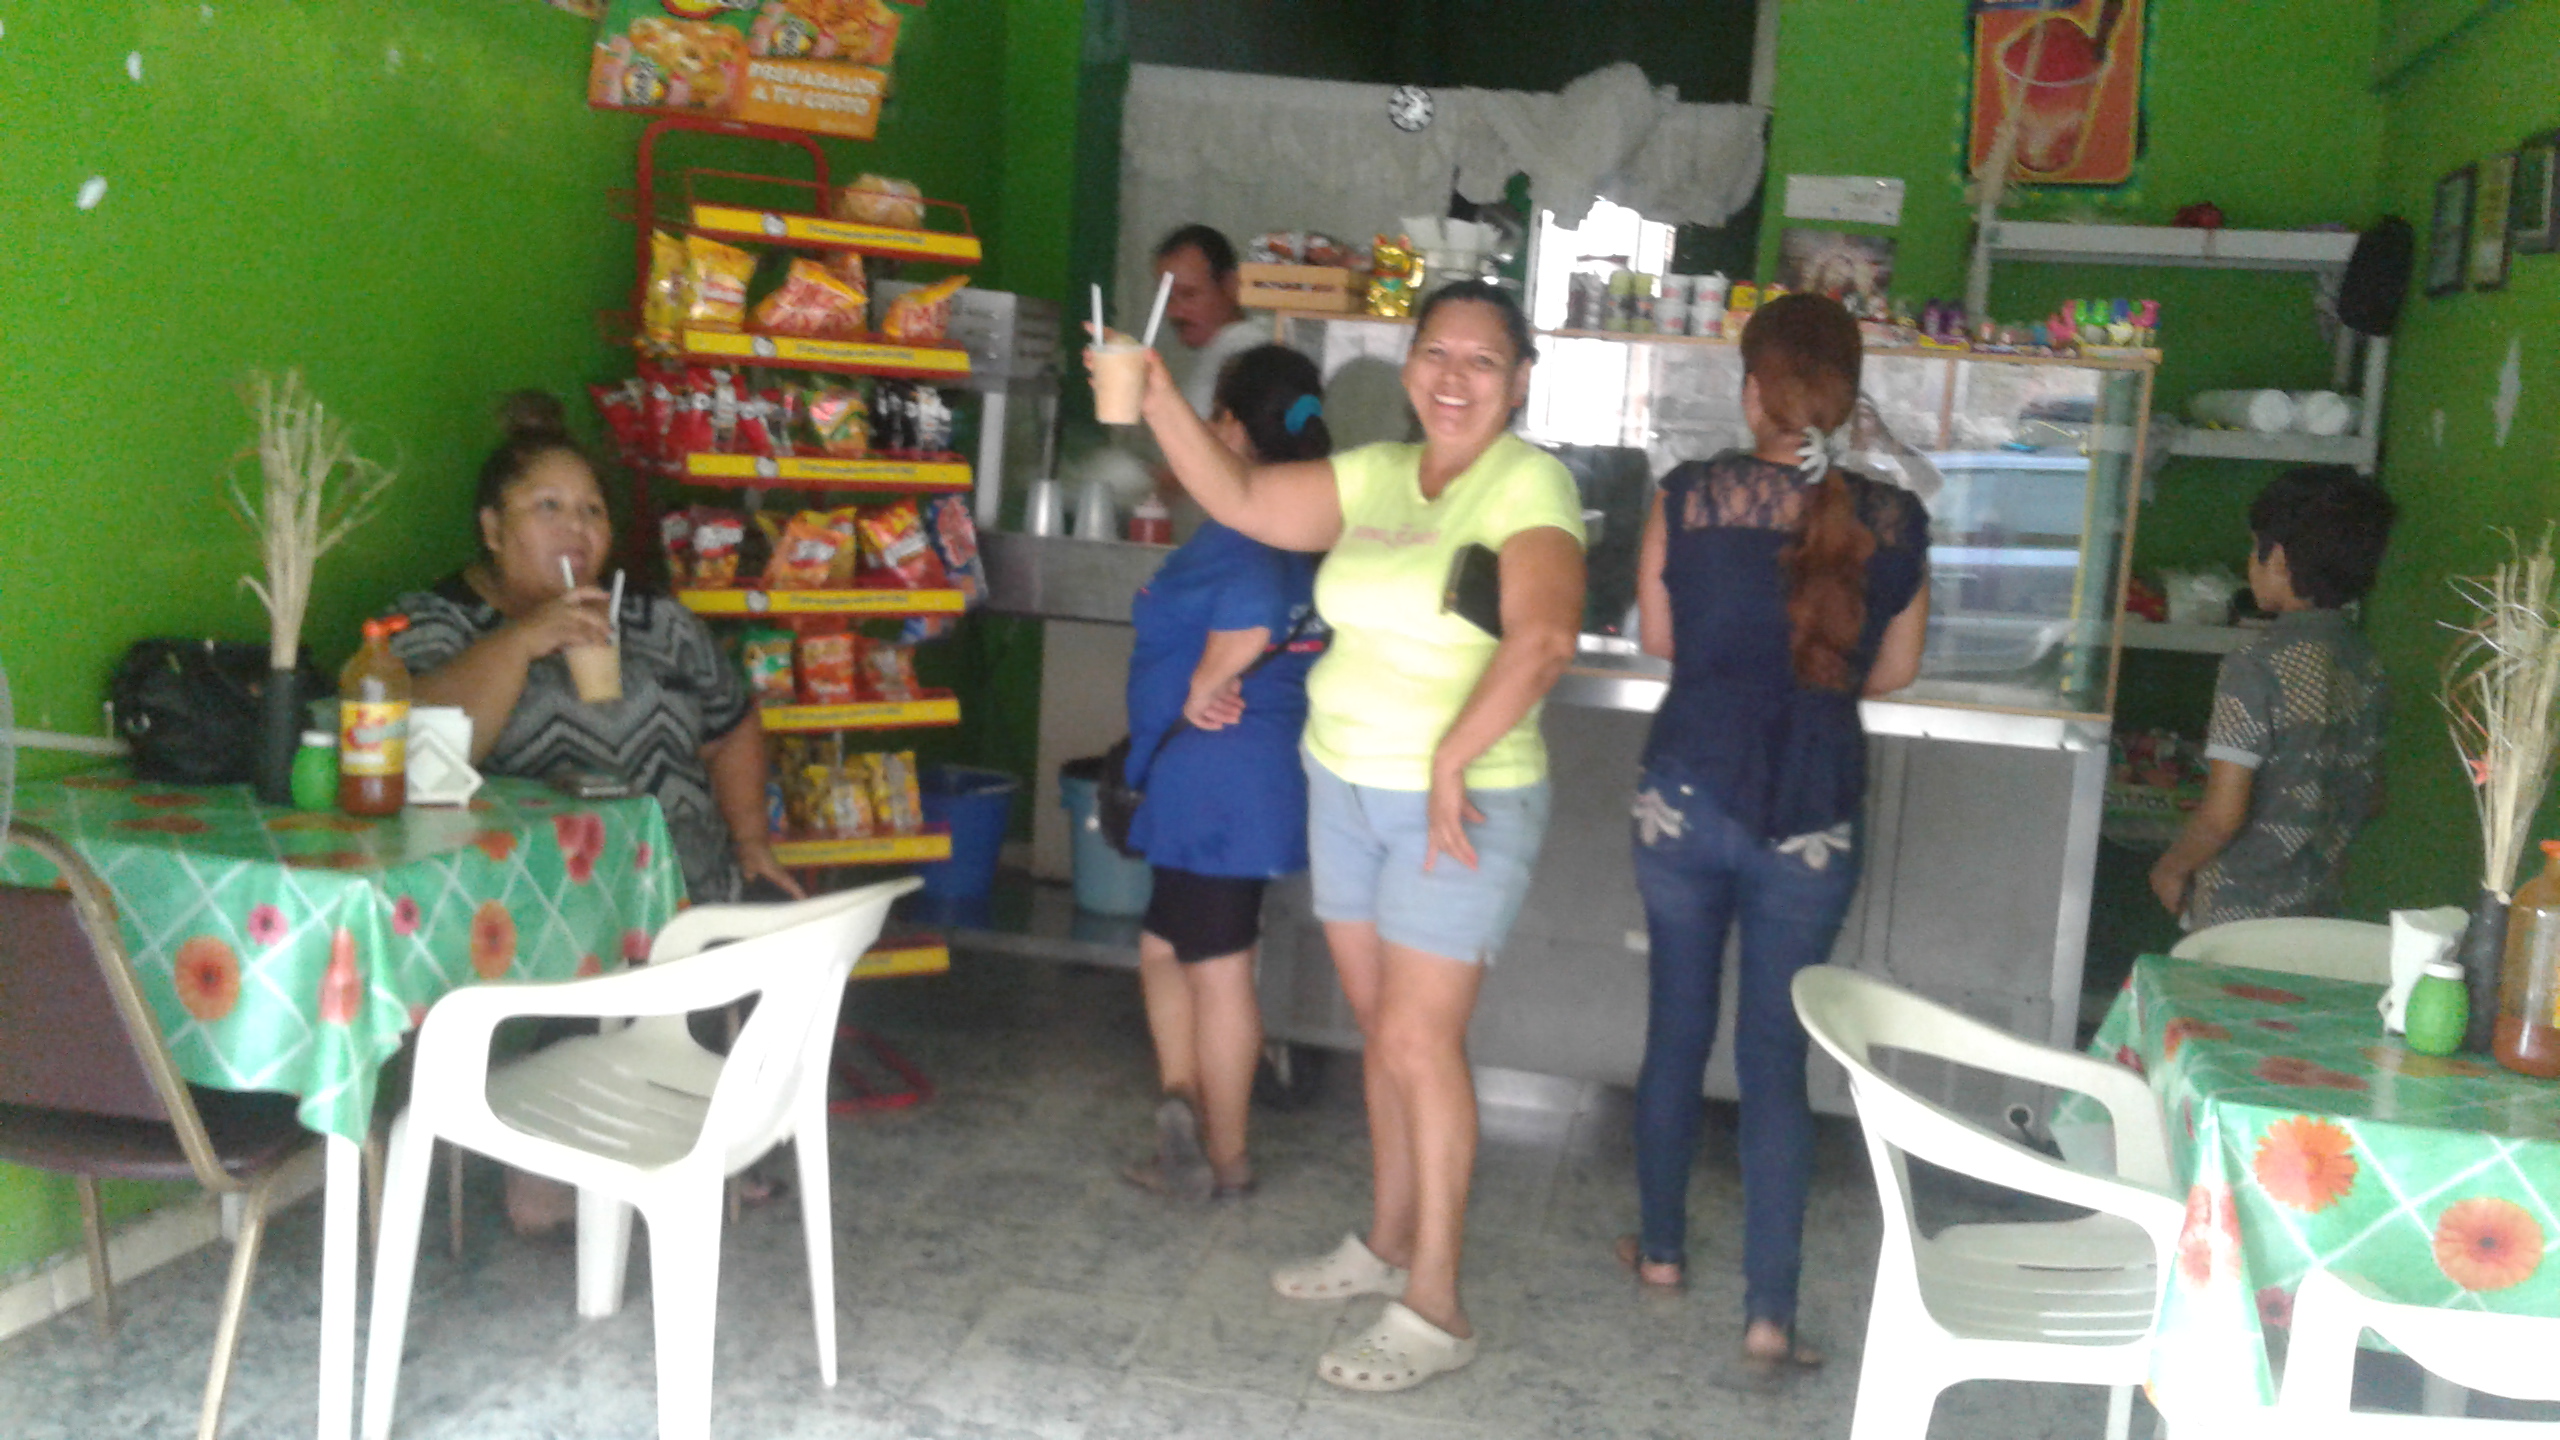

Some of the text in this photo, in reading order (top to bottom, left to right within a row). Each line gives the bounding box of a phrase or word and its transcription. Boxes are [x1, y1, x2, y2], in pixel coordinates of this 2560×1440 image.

[751, 83, 870, 116] A TU GUSTO
